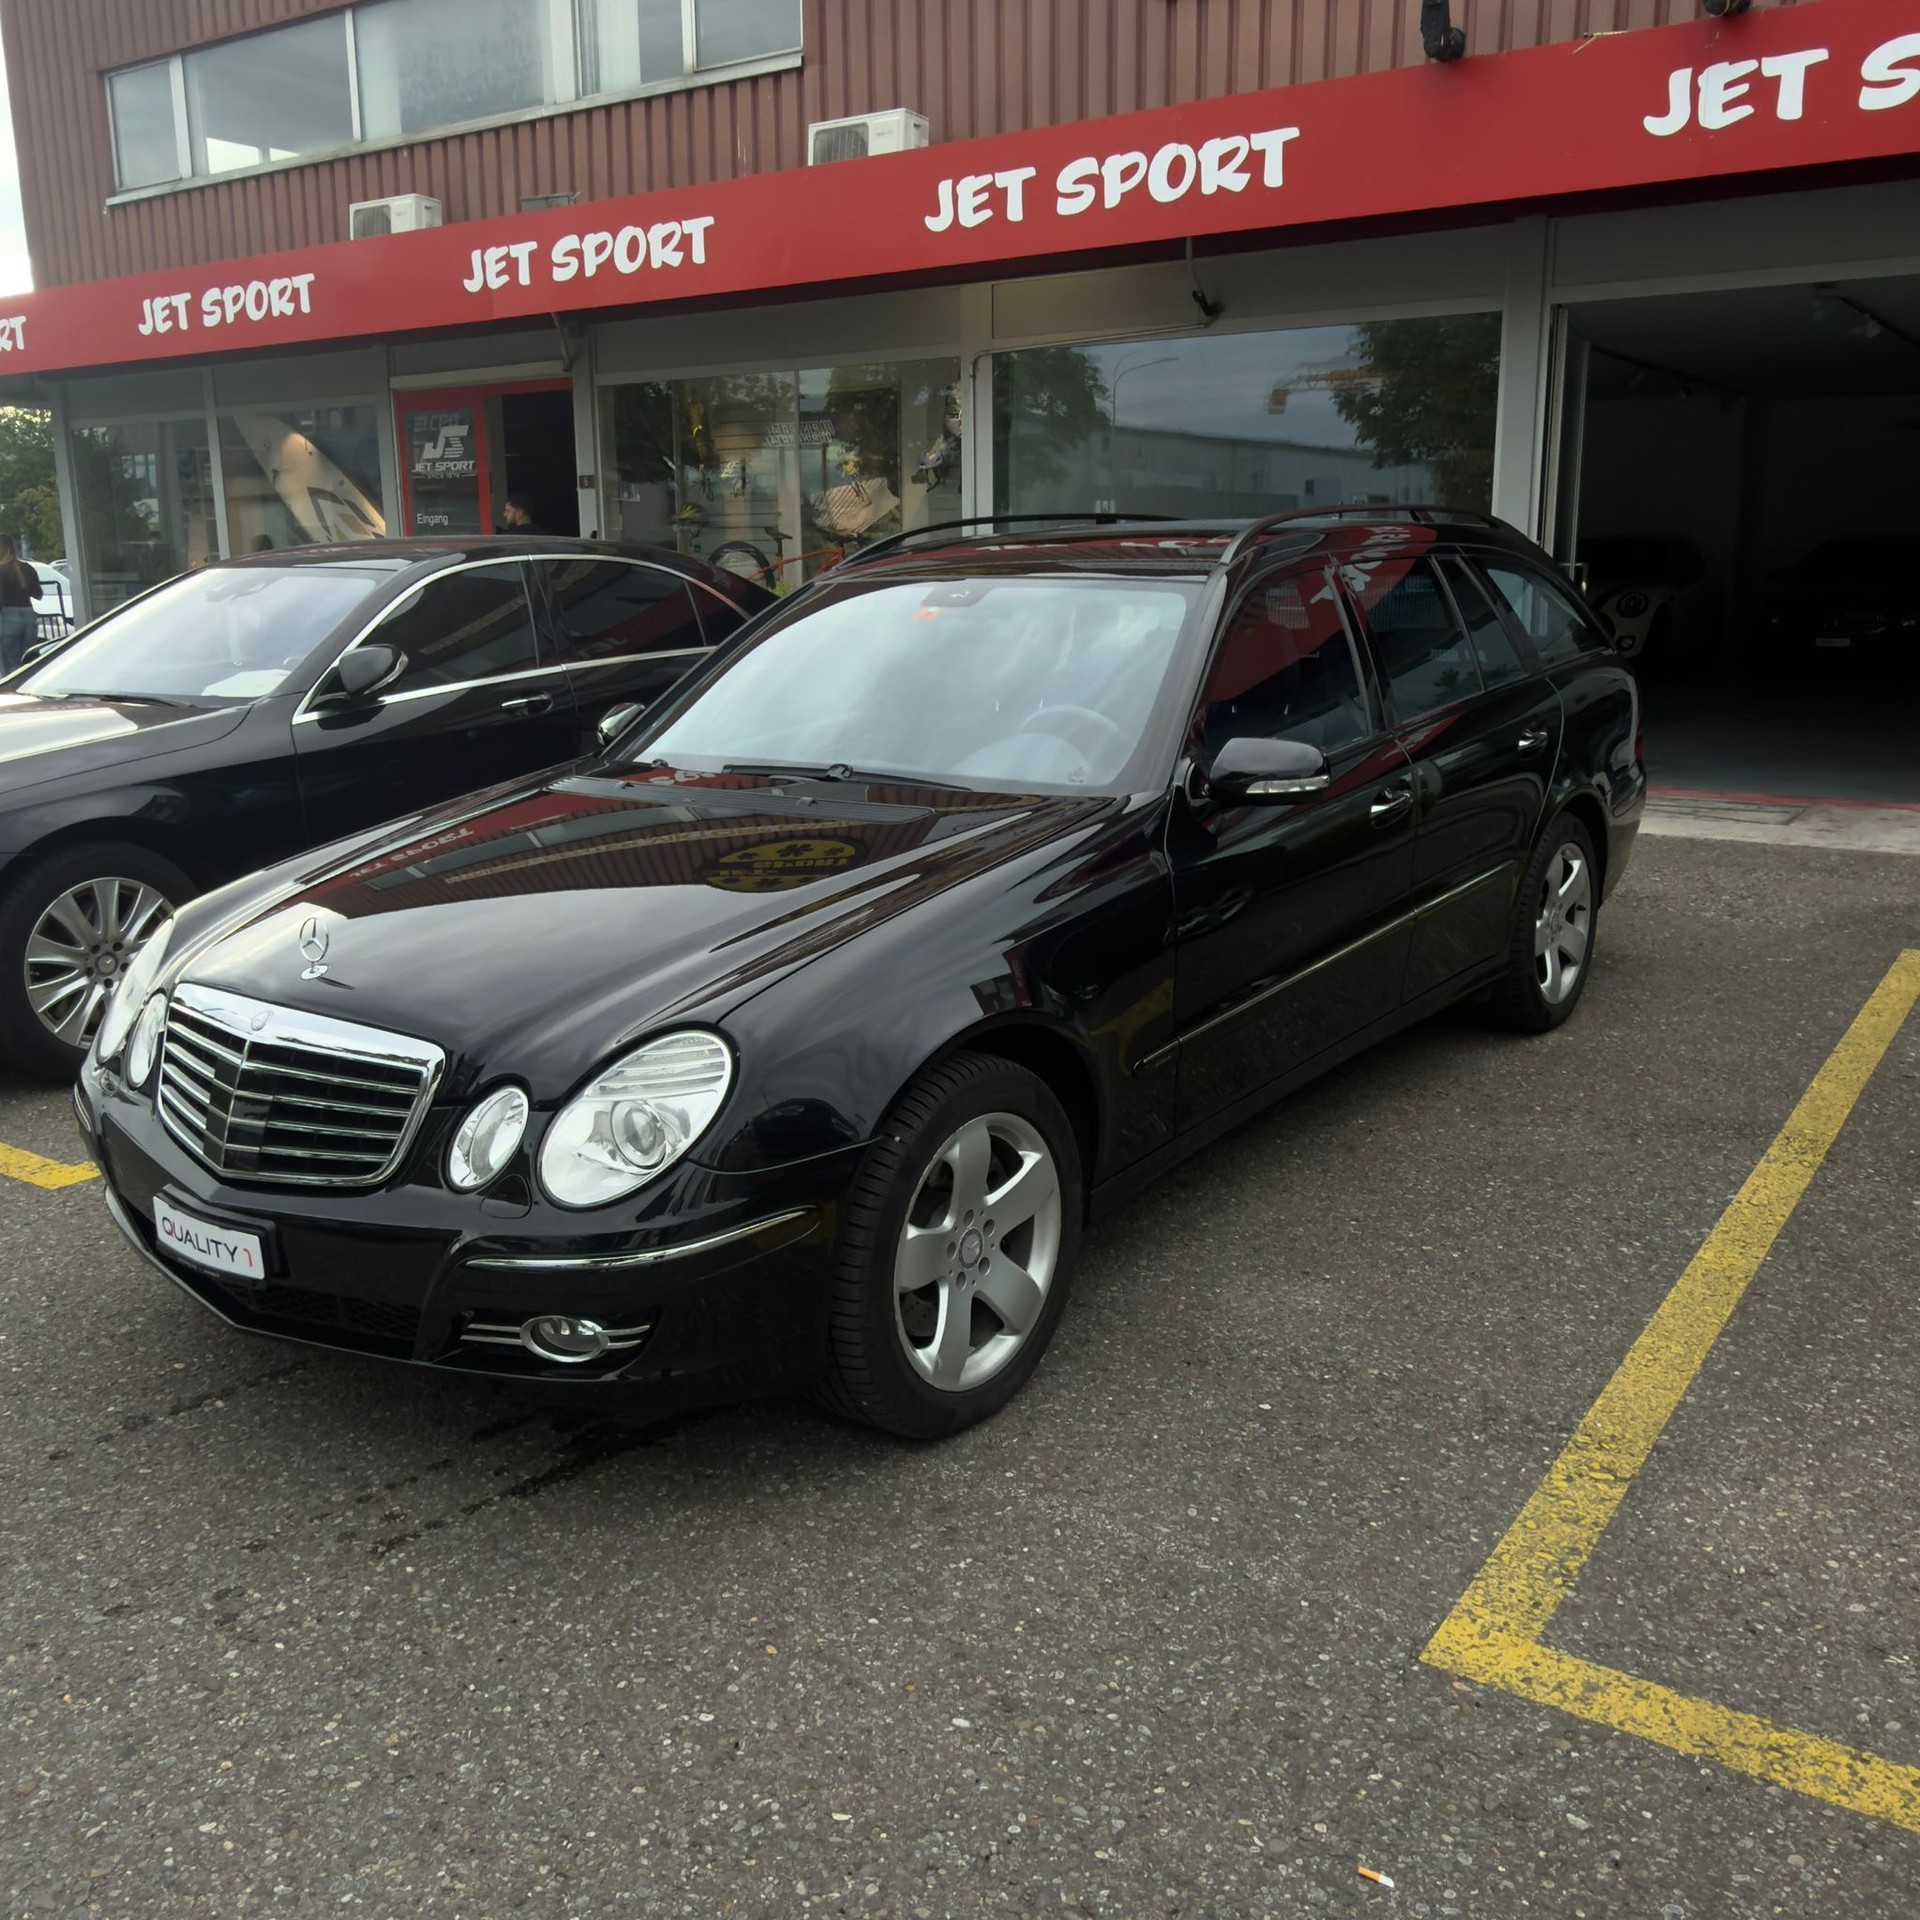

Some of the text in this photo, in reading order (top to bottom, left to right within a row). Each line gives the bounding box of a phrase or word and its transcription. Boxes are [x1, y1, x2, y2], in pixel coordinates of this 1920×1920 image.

[1642, 48, 1830, 137] JET
[924, 126, 1300, 233] JET SPORT
[462, 215, 715, 293] JET SPORT
[137, 272, 316, 336] JET SPORT
[411, 461, 475, 473] JET SPORT
[417, 513, 449, 526] Eingang
[161, 1216, 238, 1263] QUALITY
